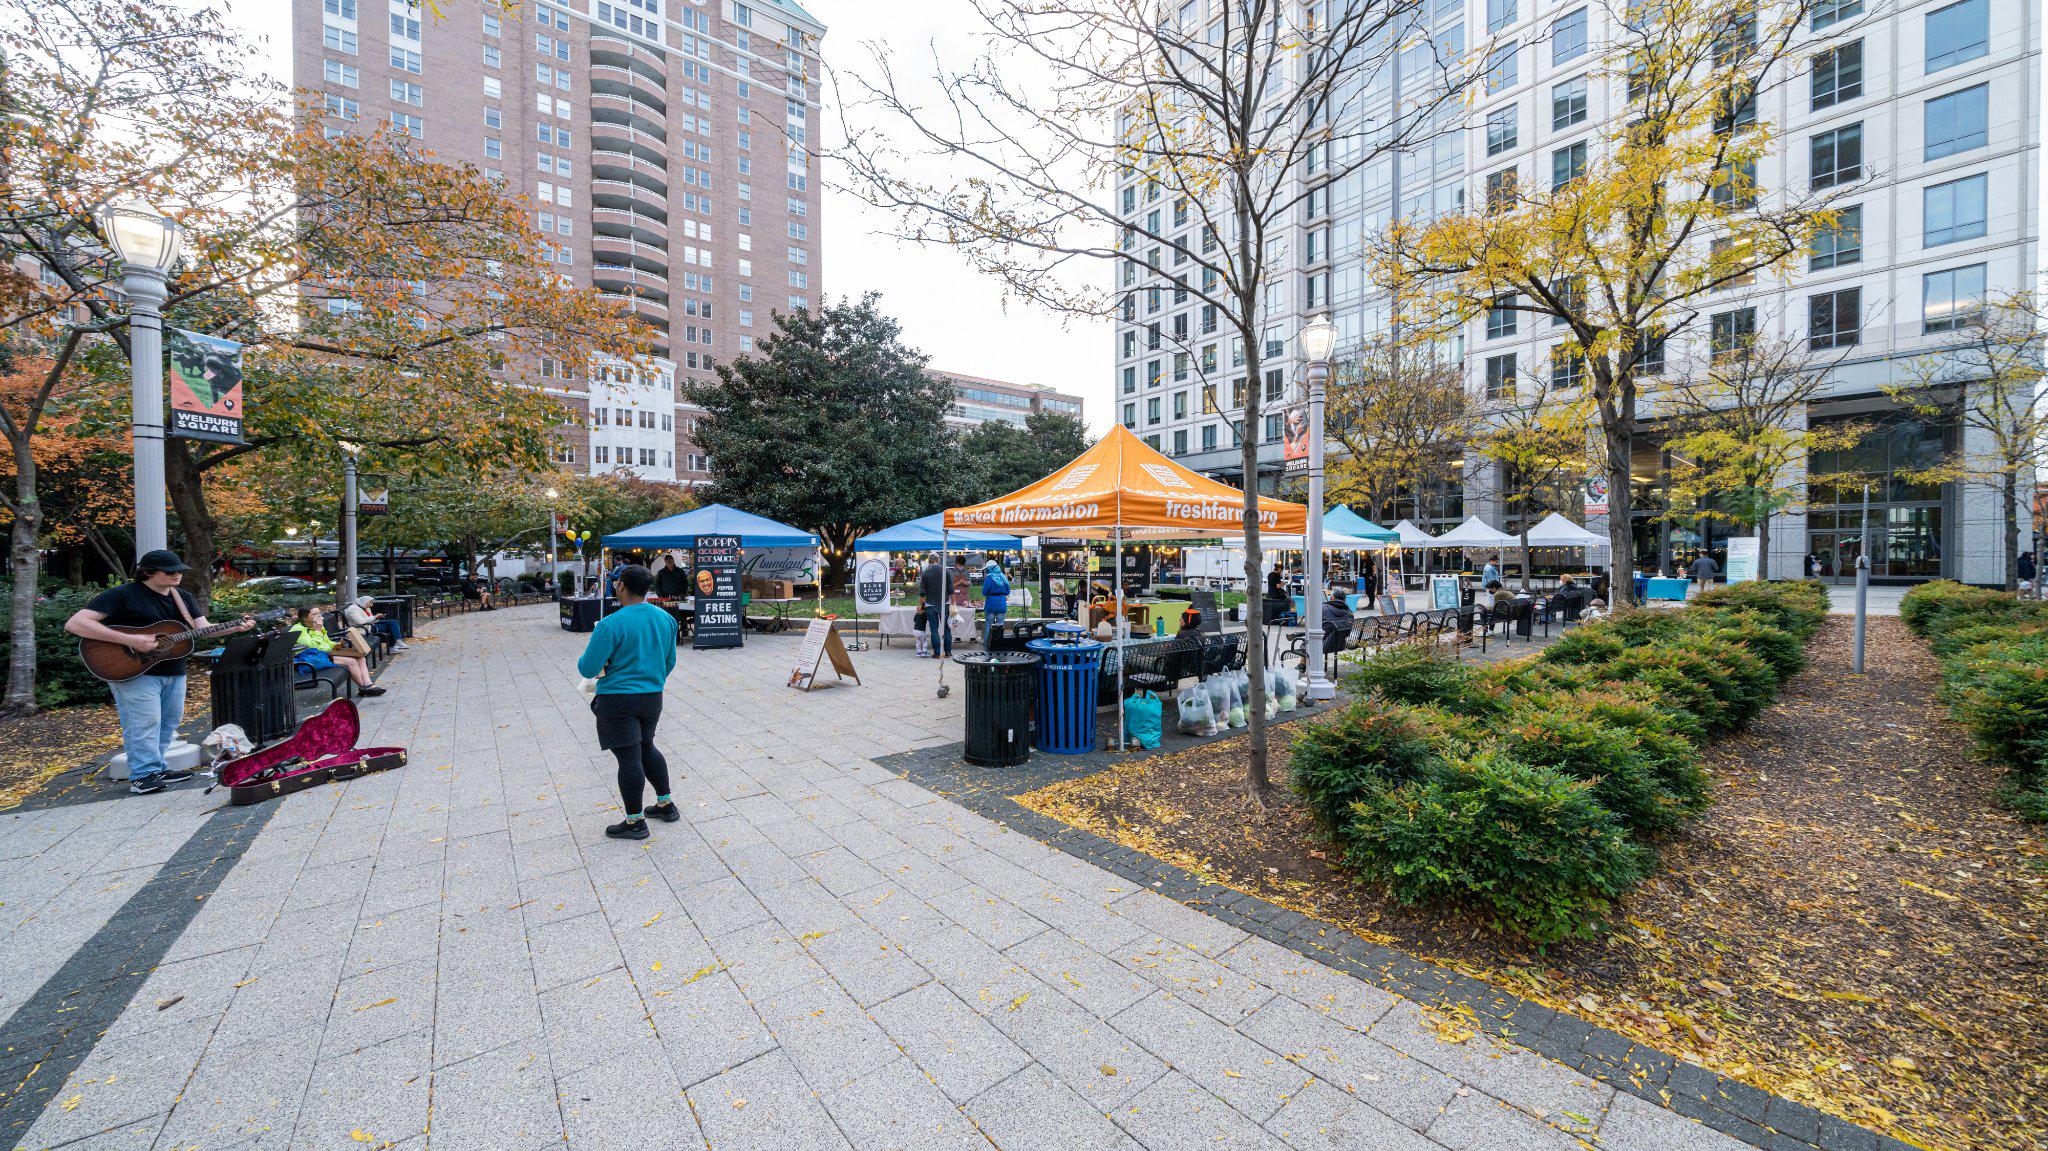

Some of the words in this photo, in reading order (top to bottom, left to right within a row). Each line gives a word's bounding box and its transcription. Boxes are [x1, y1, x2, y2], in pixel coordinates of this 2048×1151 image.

[177, 412, 238, 428] WELBURN
[177, 421, 239, 435] SQUARE
[1286, 464, 1308, 472] SQUARE
[953, 508, 997, 525] Market
[1000, 501, 1099, 523] Information
[698, 538, 738, 548] POPPI'S
[741, 554, 811, 575] Abundant
[706, 602, 732, 612] FREE
[700, 614, 738, 624] TASTING
